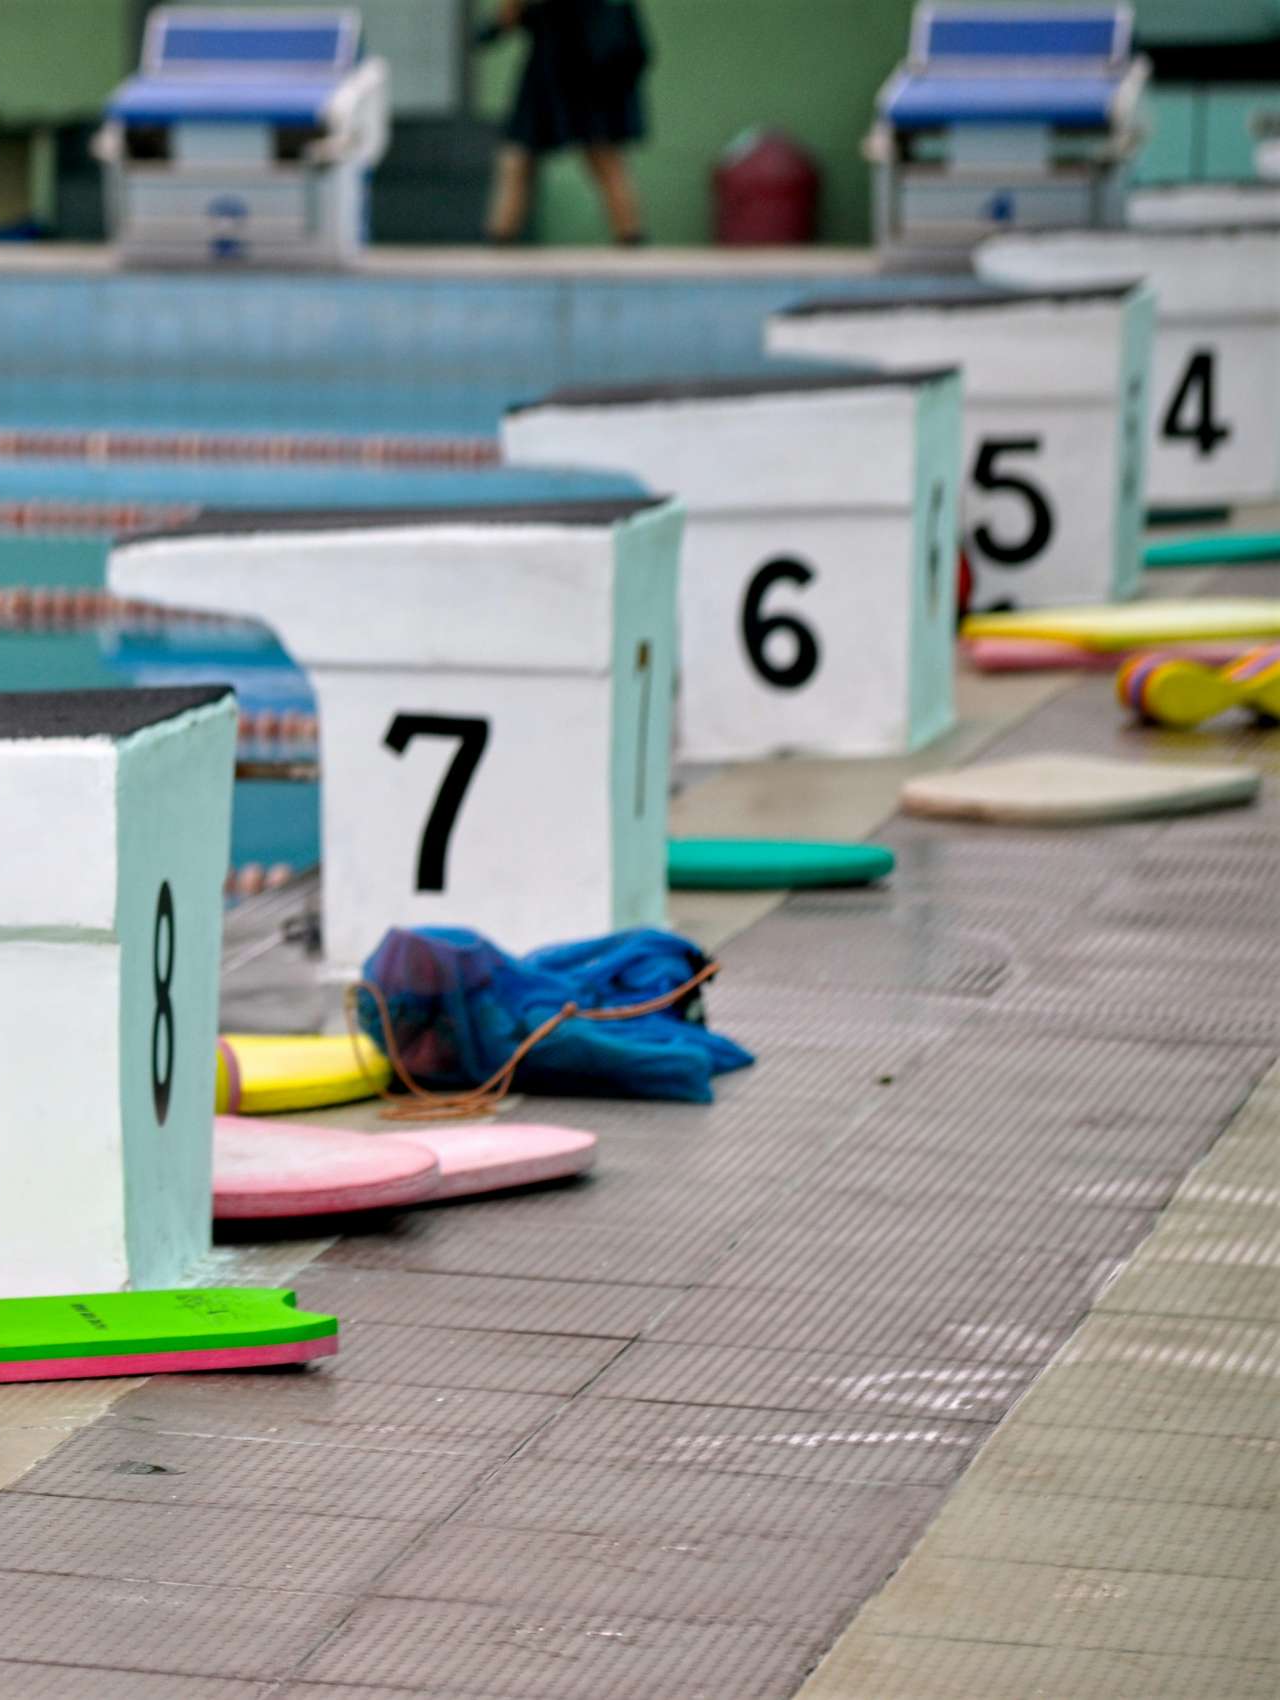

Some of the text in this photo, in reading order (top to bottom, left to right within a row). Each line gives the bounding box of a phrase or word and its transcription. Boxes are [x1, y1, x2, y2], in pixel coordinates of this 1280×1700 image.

[1161, 348, 1232, 457] 4
[971, 434, 1055, 565] 5
[740, 555, 820, 689] 6
[380, 710, 493, 895] 7
[151, 879, 175, 1127] 8
